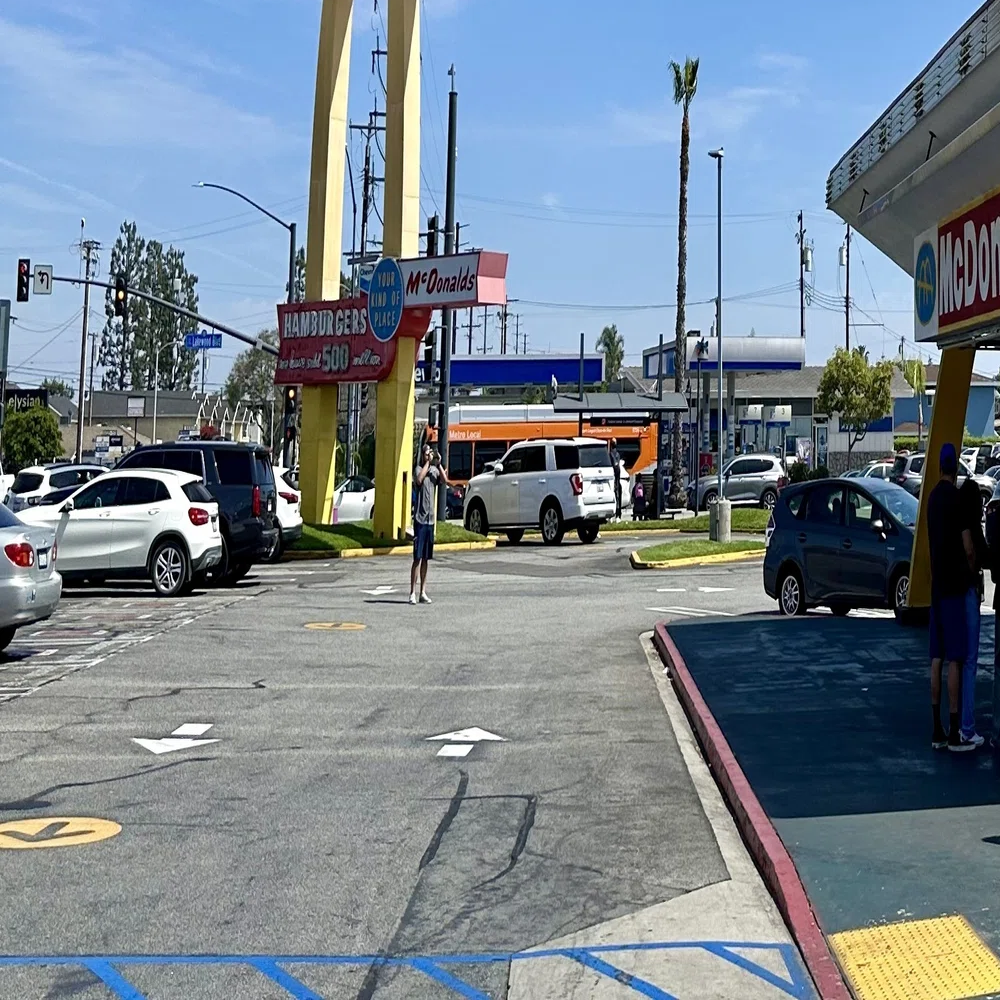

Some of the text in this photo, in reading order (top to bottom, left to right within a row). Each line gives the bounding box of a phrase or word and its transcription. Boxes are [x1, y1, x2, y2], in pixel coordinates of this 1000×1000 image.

[378, 271, 395, 287] YOUR
[371, 290, 400, 307] KIND OF
[283, 308, 367, 338] HAMBURGERS
[374, 311, 396, 327] PLACE
[322, 343, 349, 373] 500
[449, 430, 481, 439] Metro Local
